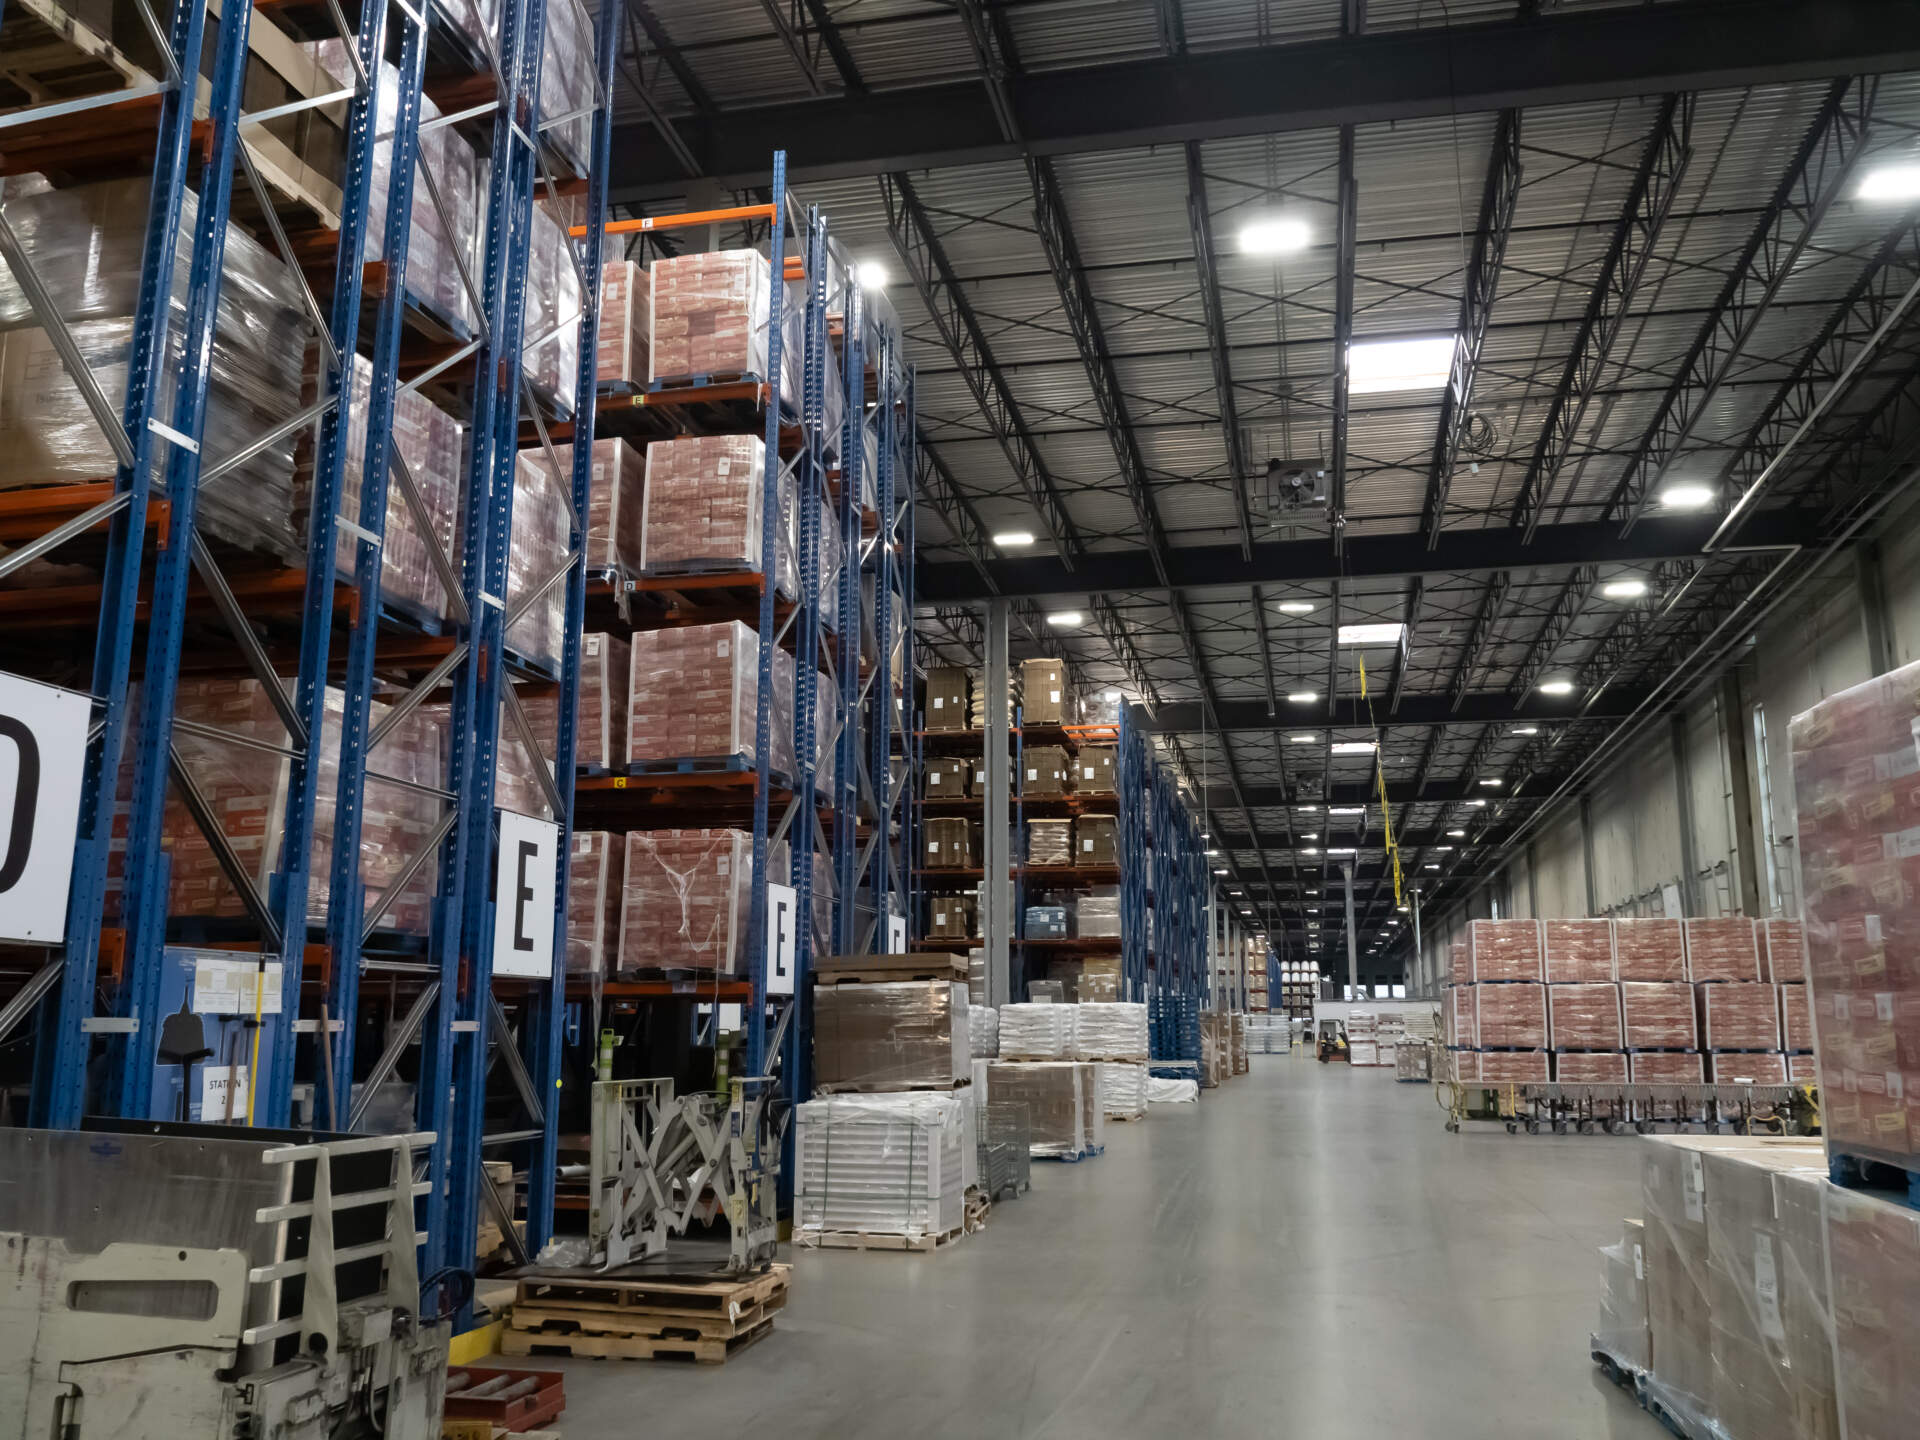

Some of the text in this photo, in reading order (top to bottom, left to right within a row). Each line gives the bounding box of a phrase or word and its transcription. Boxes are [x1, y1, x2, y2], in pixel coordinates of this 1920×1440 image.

[514, 840, 538, 952] E
[776, 901, 787, 977] E
[209, 1080, 241, 1090] STATIN
